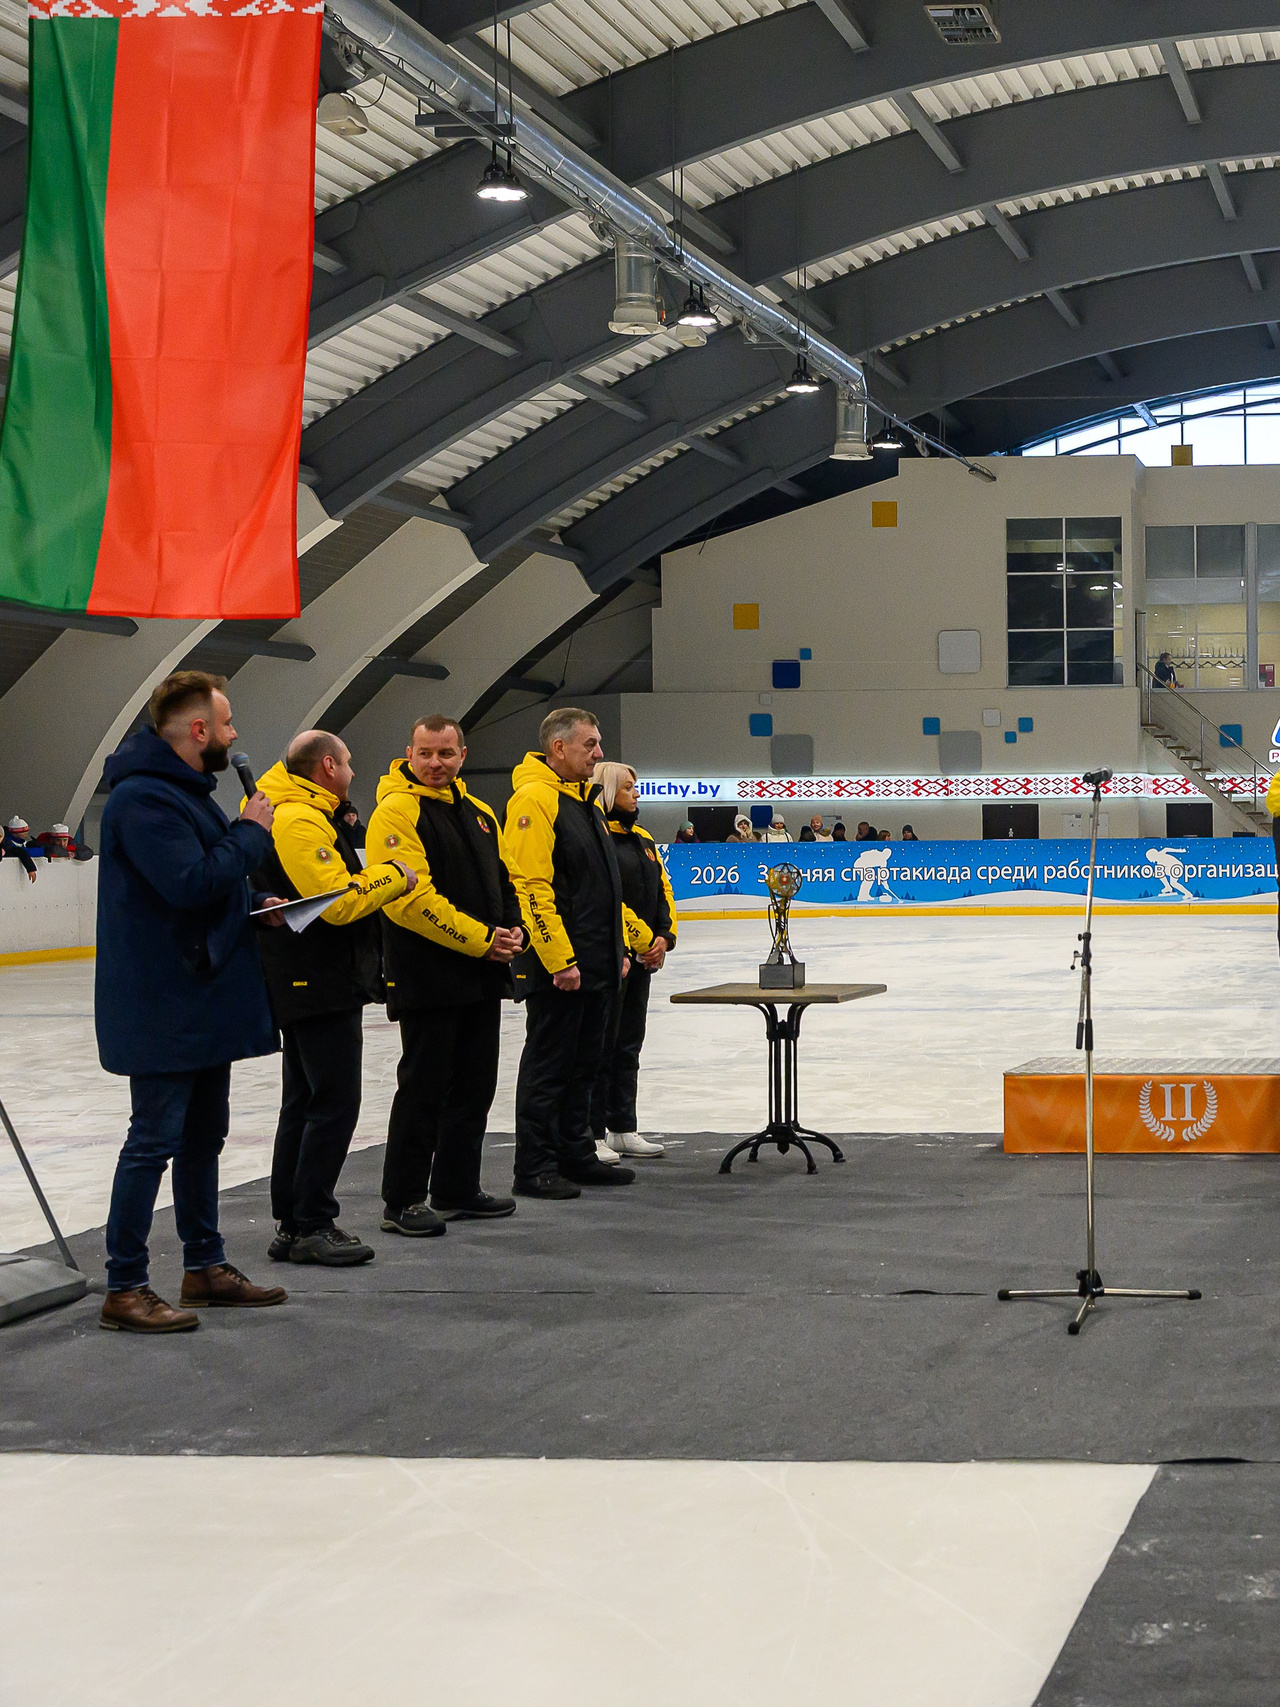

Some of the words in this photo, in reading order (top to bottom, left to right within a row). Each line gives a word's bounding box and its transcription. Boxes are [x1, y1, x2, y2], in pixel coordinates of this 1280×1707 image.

[690, 865, 740, 884] 2026
[757, 864, 835, 883] Зняя
[840, 864, 971, 884] спартакиада
[976, 864, 1038, 885] среди
[1043, 860, 1166, 884] работников
[1170, 863, 1279, 883] организац
[421, 907, 468, 944] BELARUS
[1159, 1083, 1197, 1121] II
